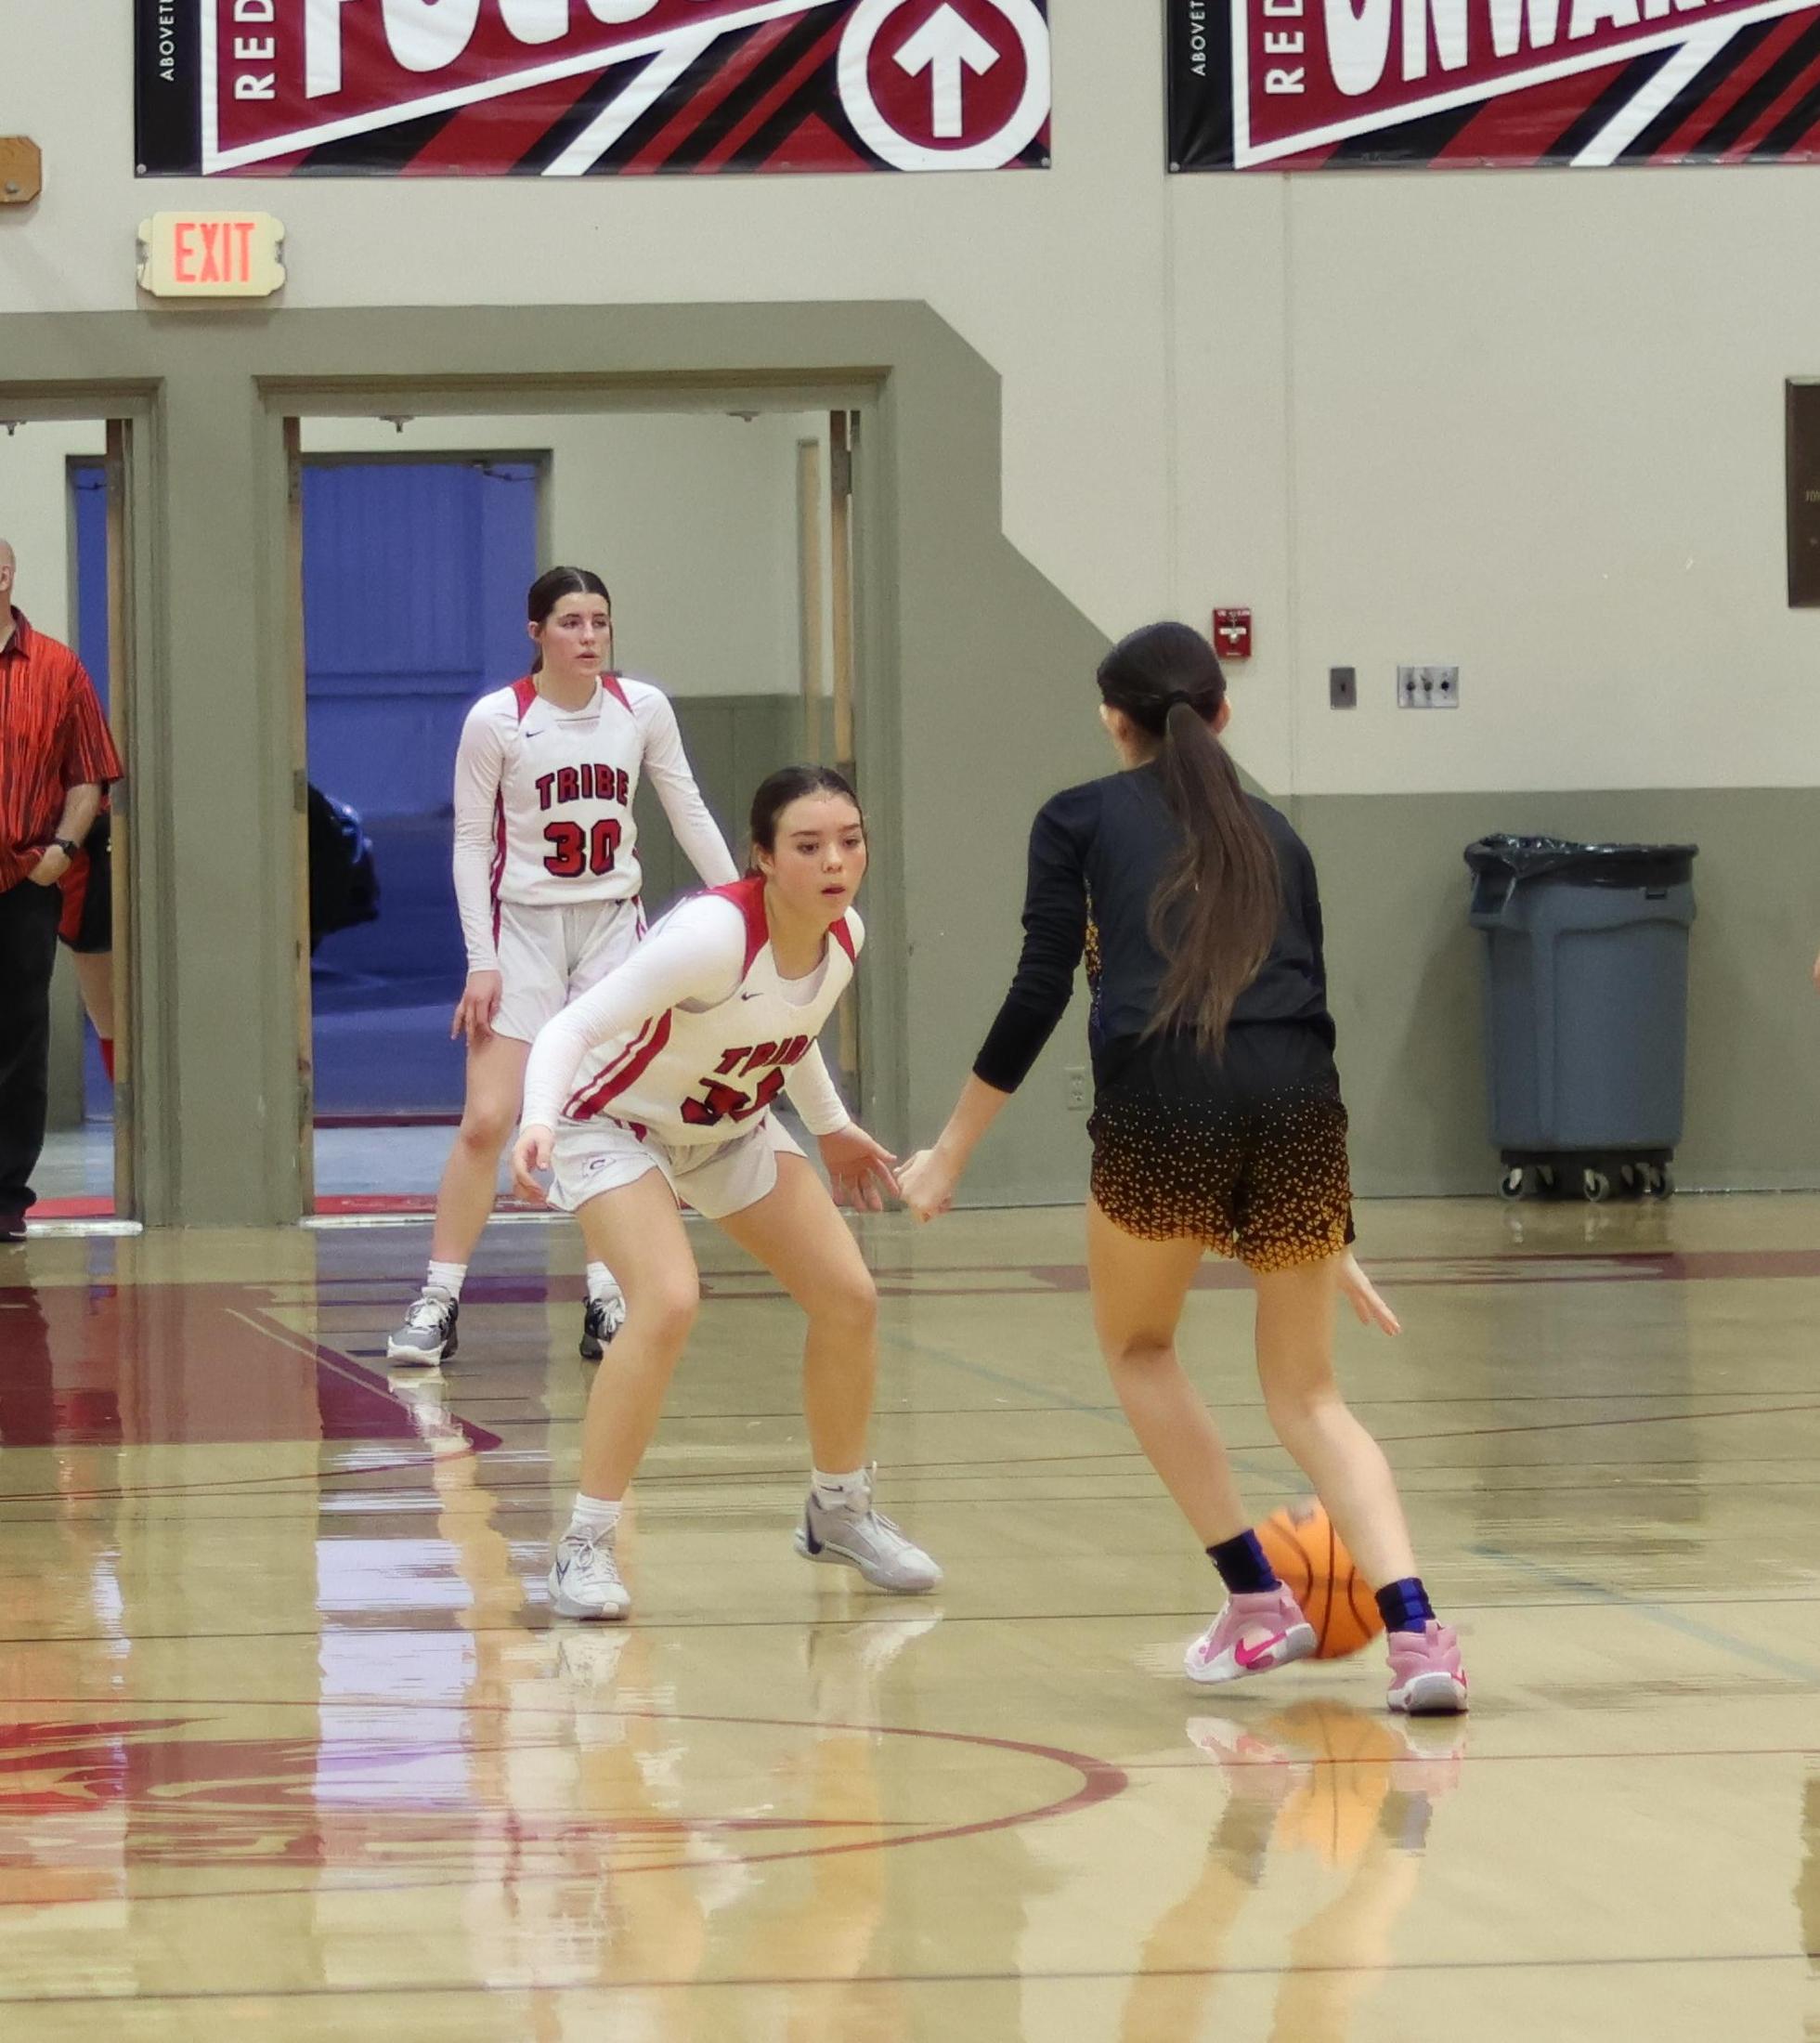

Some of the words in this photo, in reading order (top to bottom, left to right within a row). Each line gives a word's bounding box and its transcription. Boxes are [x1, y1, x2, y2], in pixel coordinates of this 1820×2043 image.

[159, 0, 175, 82] ABOVET
[174, 222, 255, 283] EXIT
[535, 763, 630, 812] TRIBE
[543, 818, 622, 878] 30
